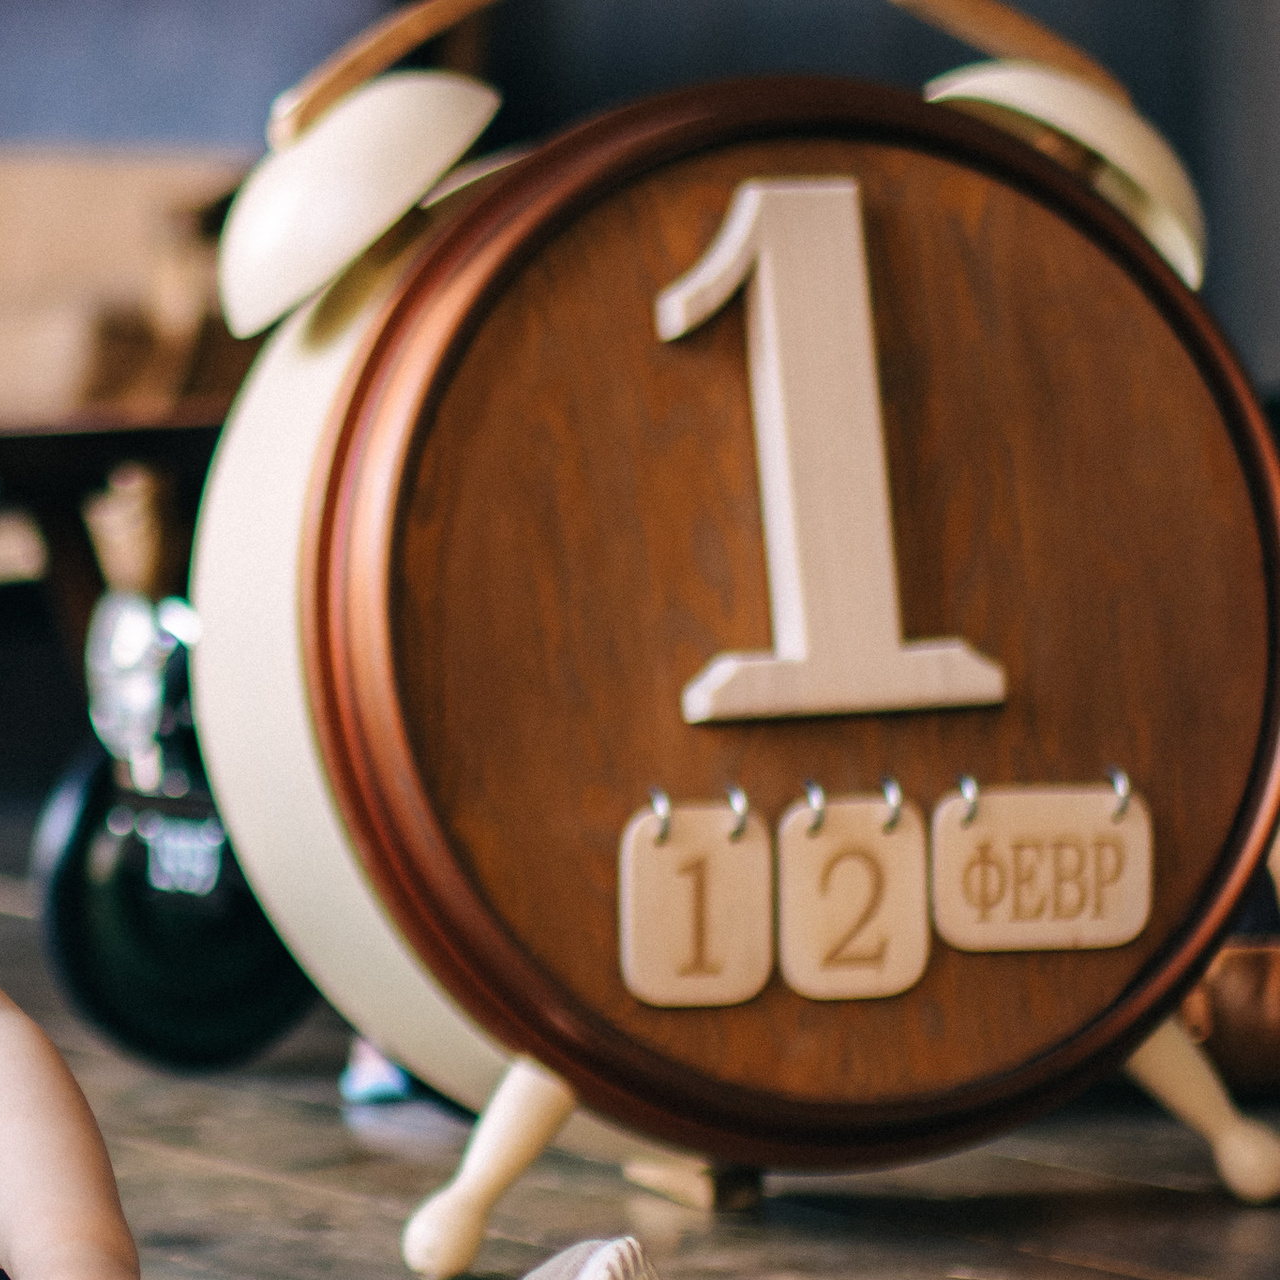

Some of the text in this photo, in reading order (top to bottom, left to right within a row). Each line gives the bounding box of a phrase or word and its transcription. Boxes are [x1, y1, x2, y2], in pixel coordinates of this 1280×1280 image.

[655, 176, 1007, 724] 1
[673, 834, 1128, 978] 1 2 ФЕВР
